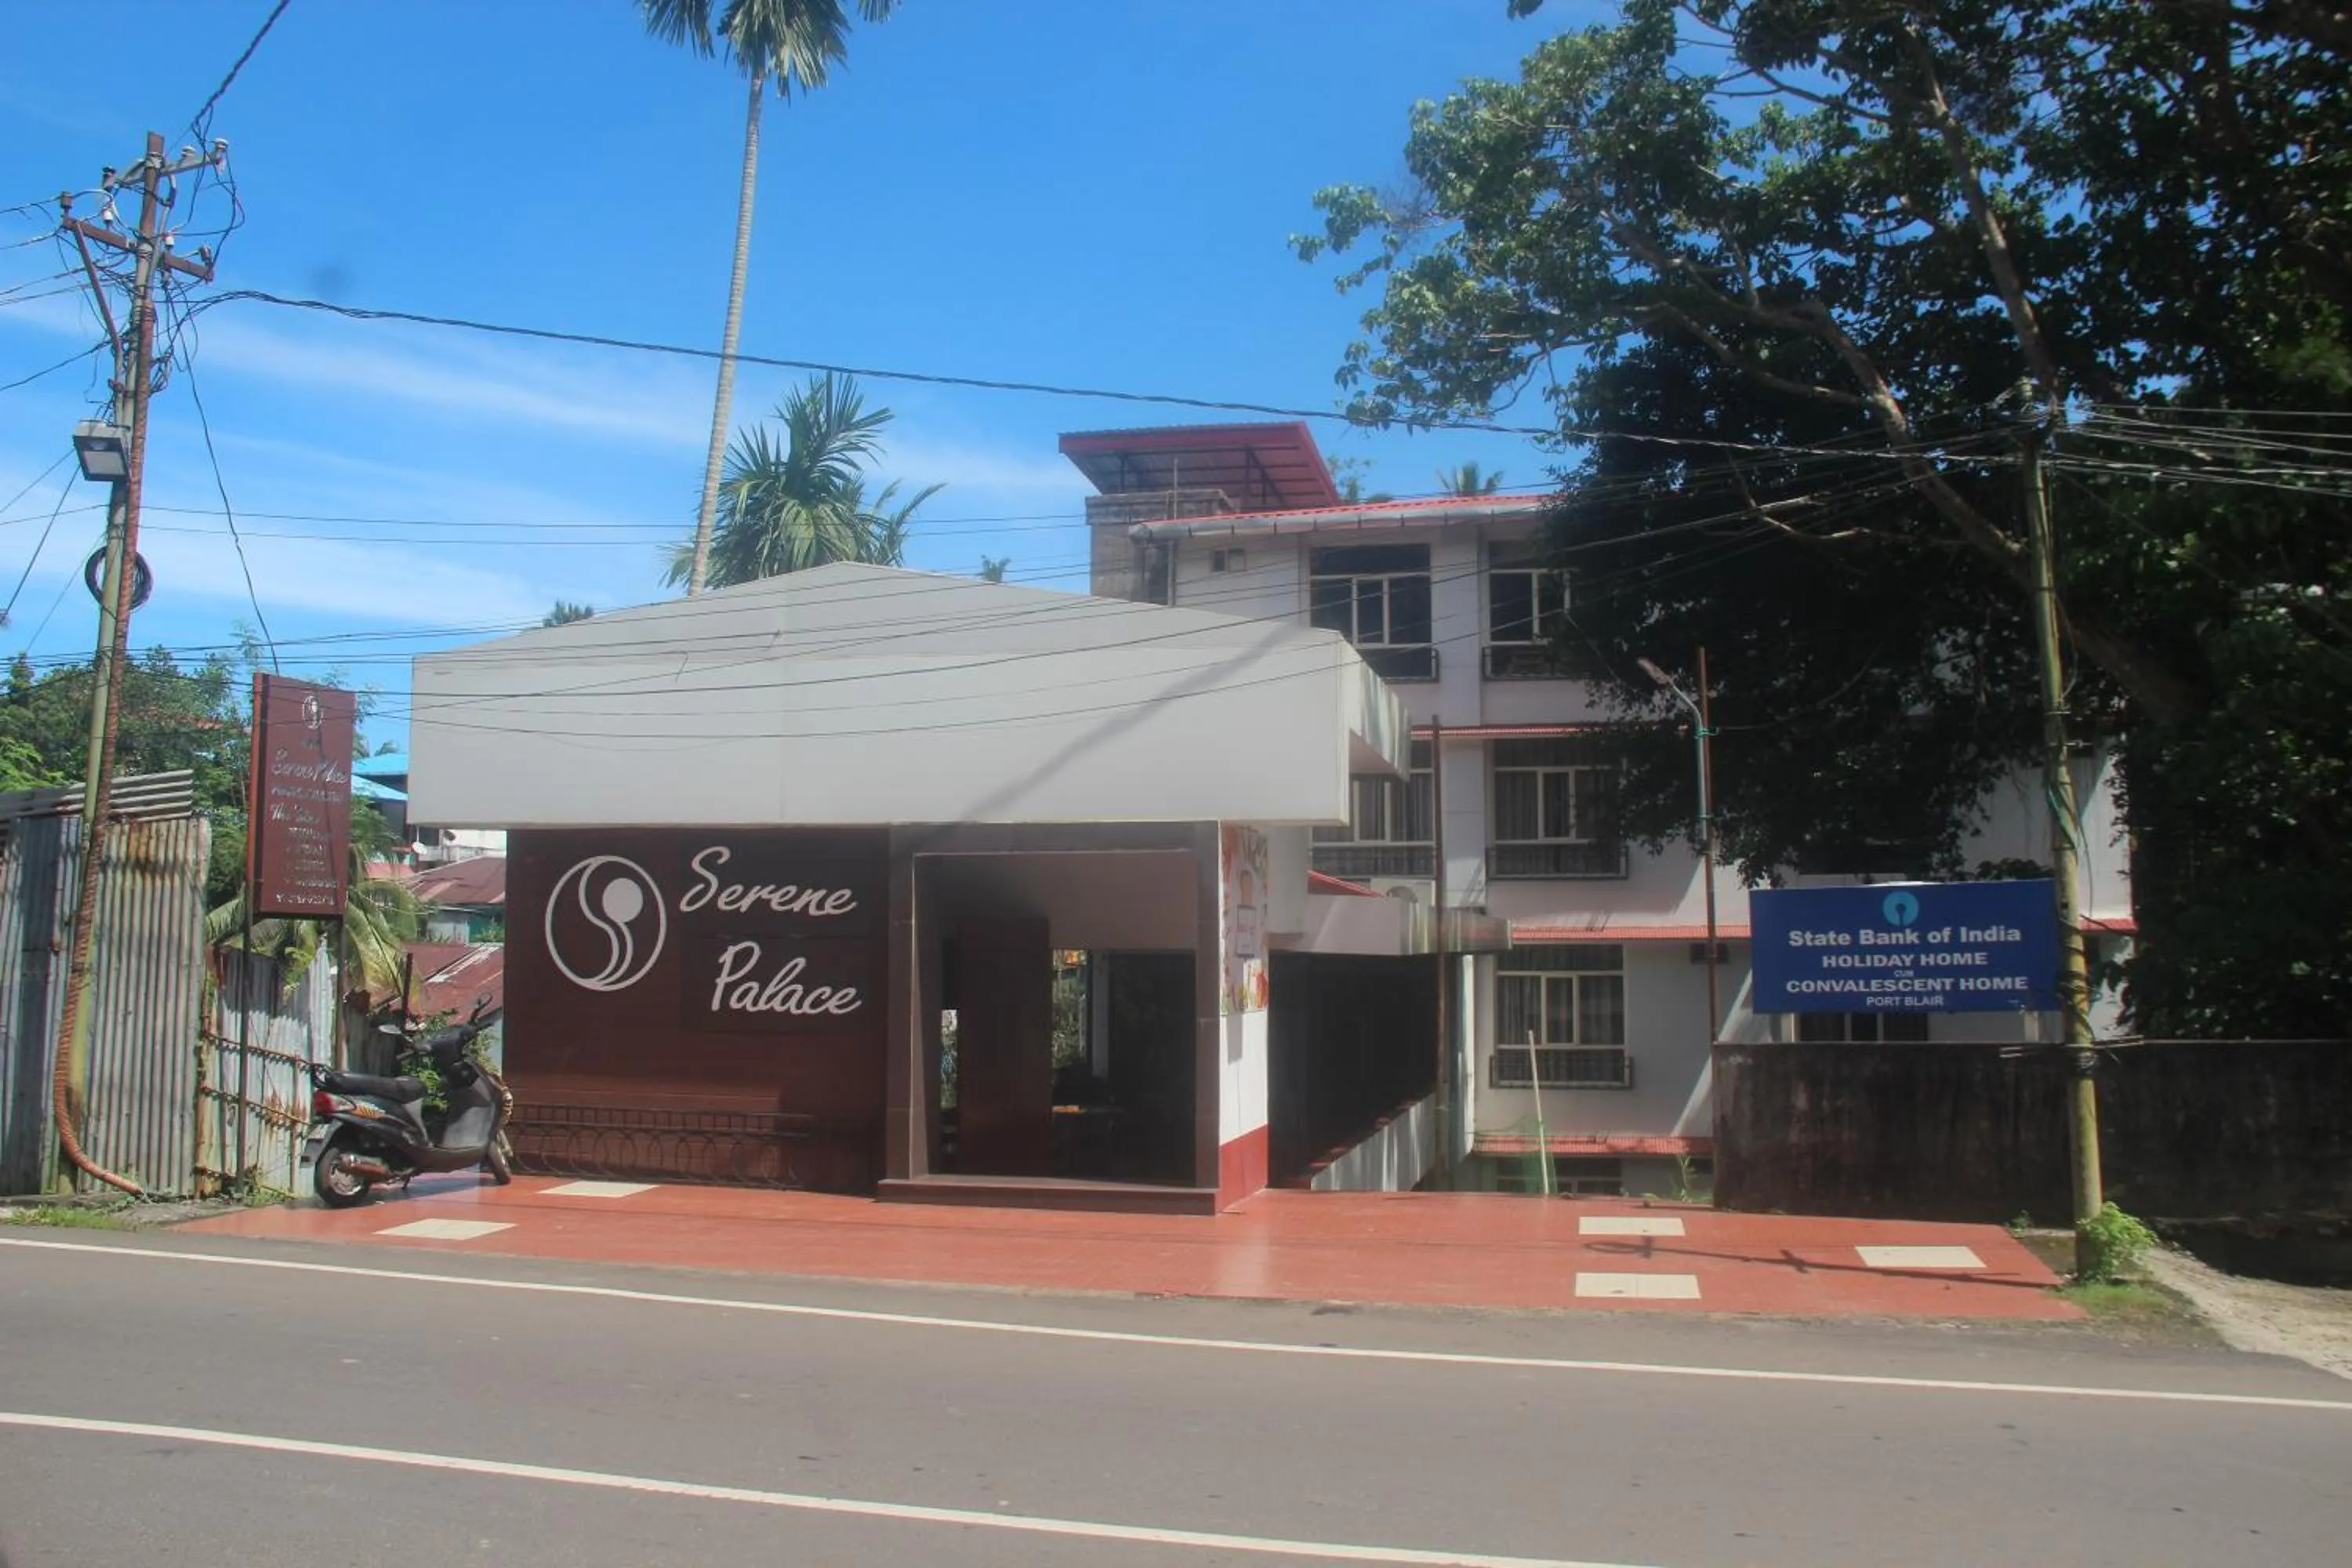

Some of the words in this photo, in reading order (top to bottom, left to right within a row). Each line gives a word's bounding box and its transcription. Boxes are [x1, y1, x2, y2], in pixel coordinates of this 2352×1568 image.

[679, 846, 858, 916] Serene
[1788, 930, 1851, 947] State
[1859, 928, 1920, 946] Bank
[1926, 927, 1952, 943] of
[1960, 925, 2021, 942] India
[1822, 953, 1915, 968] HOLIDAY
[1920, 952, 1987, 966] HOME
[710, 940, 862, 1015] Palace
[1786, 978, 1954, 993] CONVALESCENT
[1959, 976, 2028, 990] HOME
[1866, 996, 1901, 1007] PORT
[1904, 995, 1944, 1006] BLAIR
